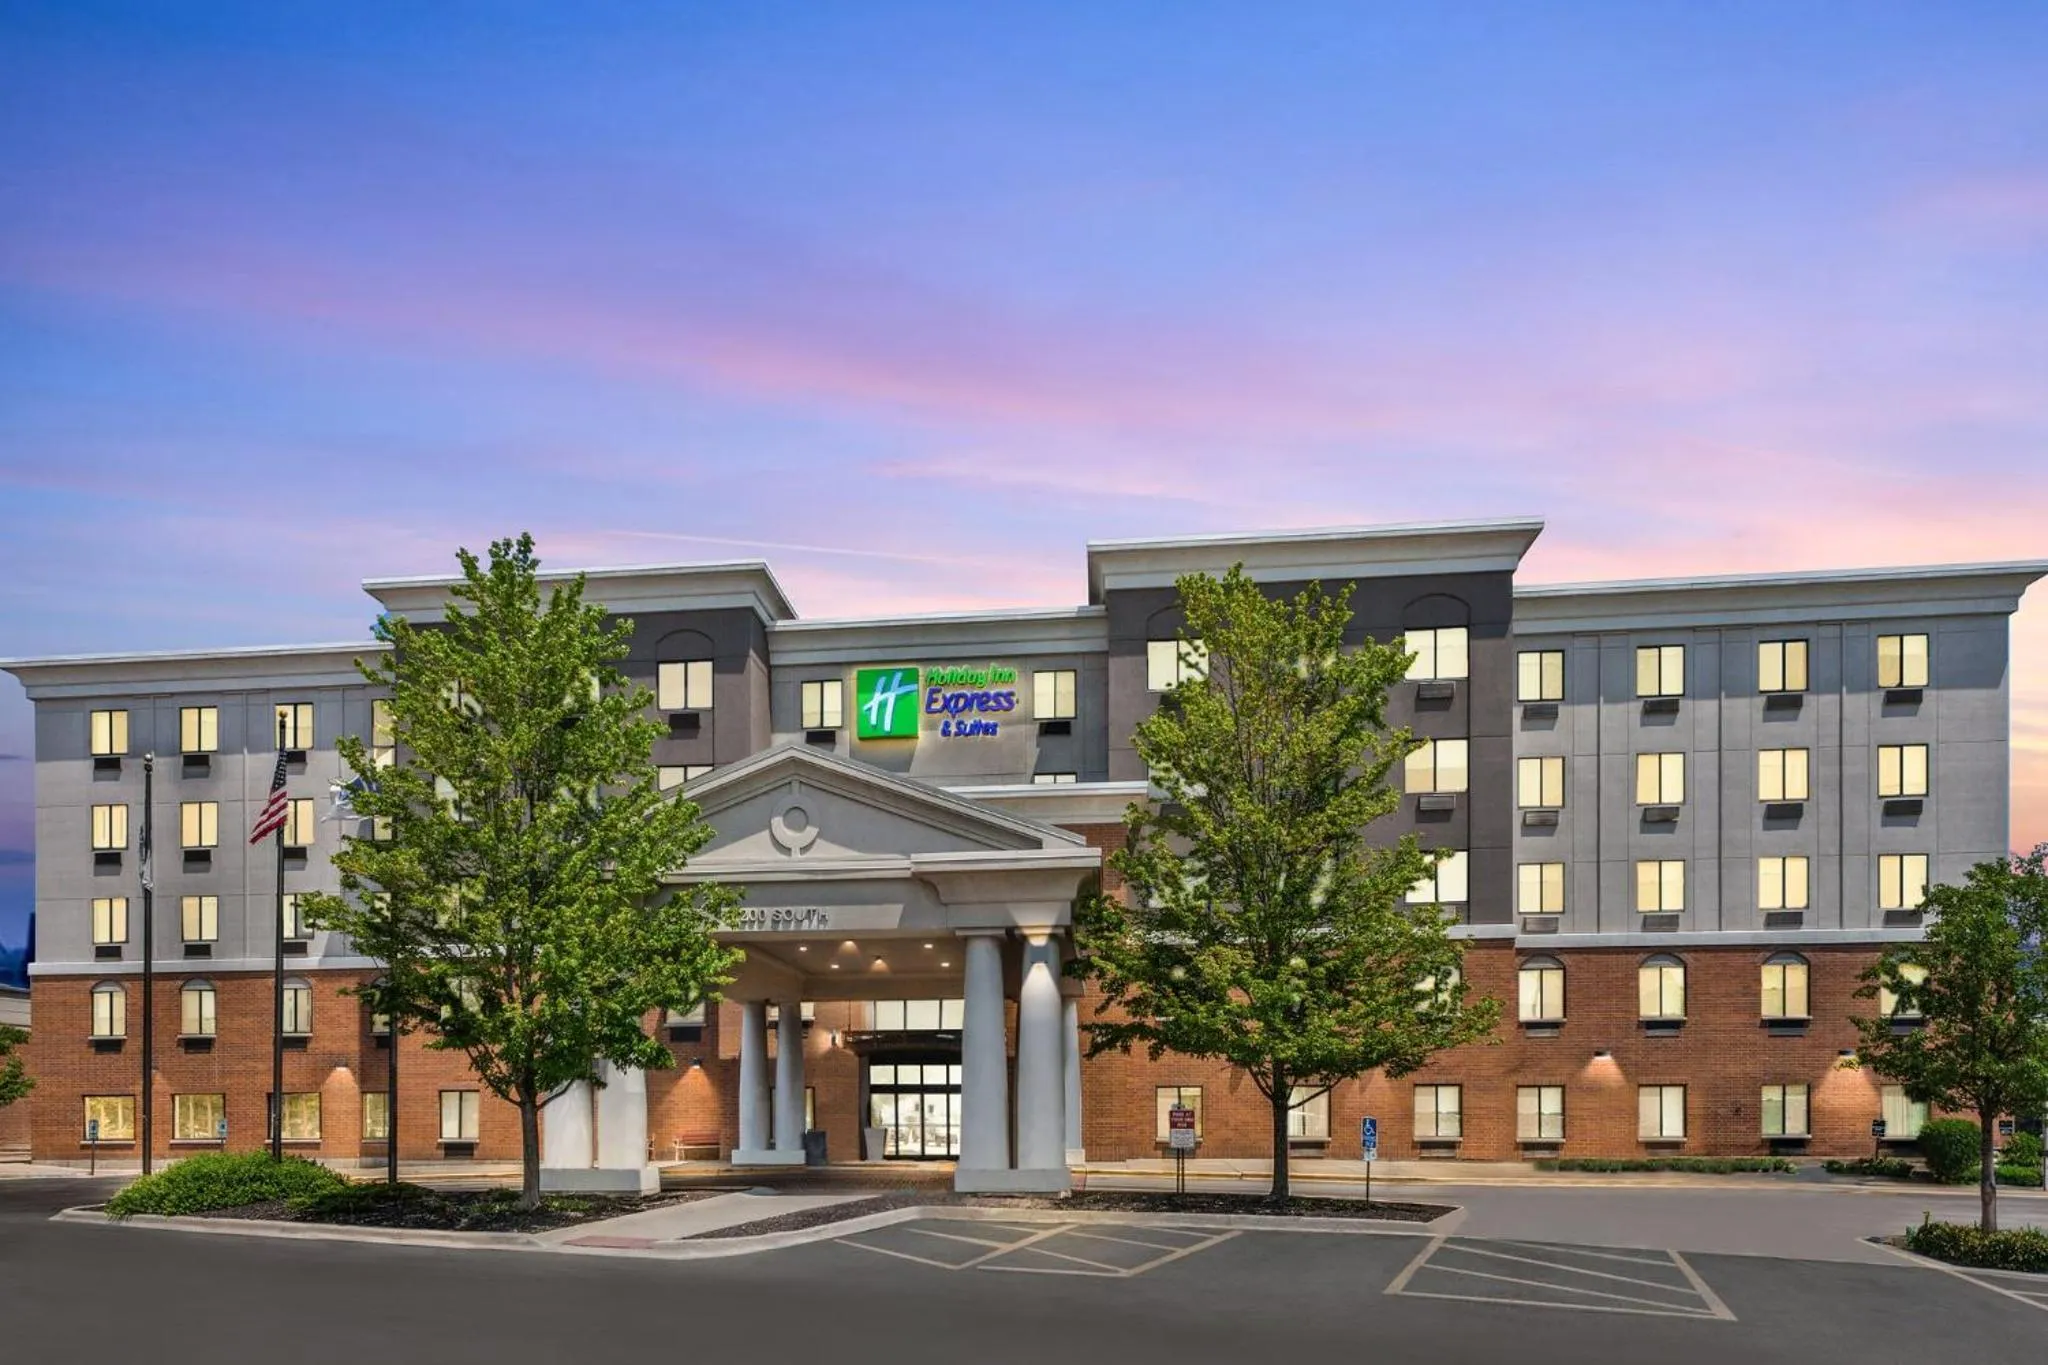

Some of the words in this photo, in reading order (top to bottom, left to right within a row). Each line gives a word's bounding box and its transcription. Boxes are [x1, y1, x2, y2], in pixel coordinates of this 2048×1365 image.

[926, 665, 986, 688] Holiday
[925, 686, 1016, 717] Express
[941, 720, 950, 737] &
[954, 719, 999, 737] Suites
